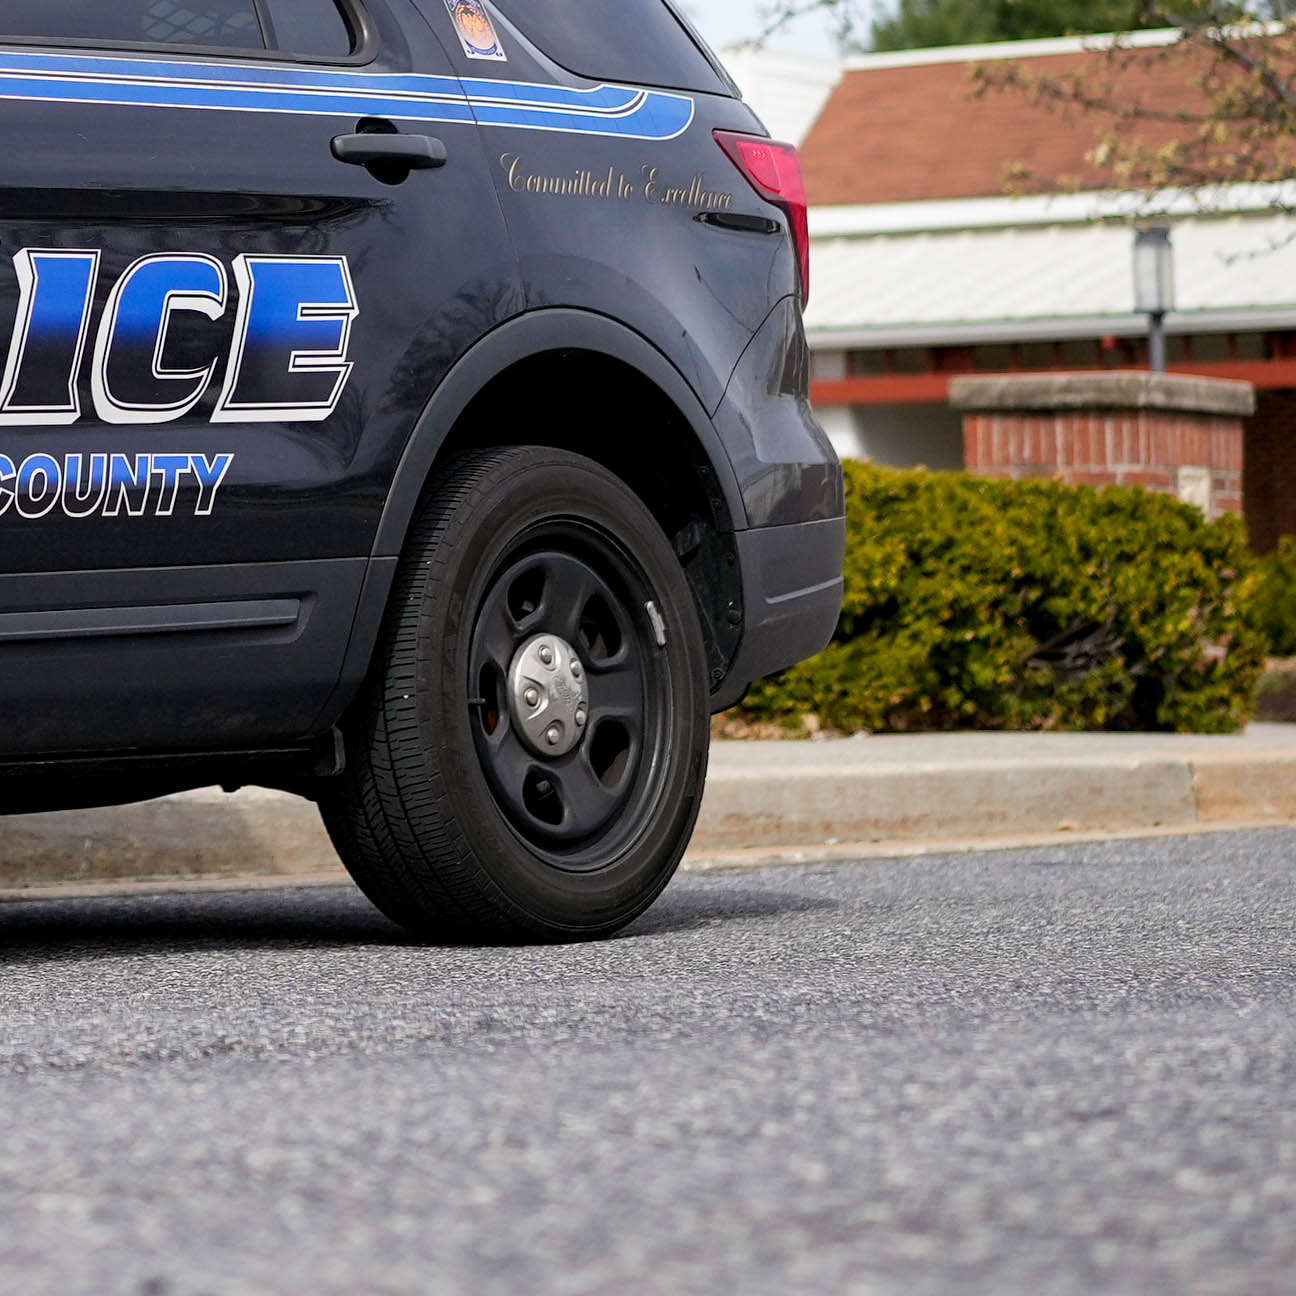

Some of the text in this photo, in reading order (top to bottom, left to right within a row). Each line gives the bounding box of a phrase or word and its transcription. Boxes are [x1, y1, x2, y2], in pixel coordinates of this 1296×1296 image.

[500, 151, 733, 209] Committed to Excellence
